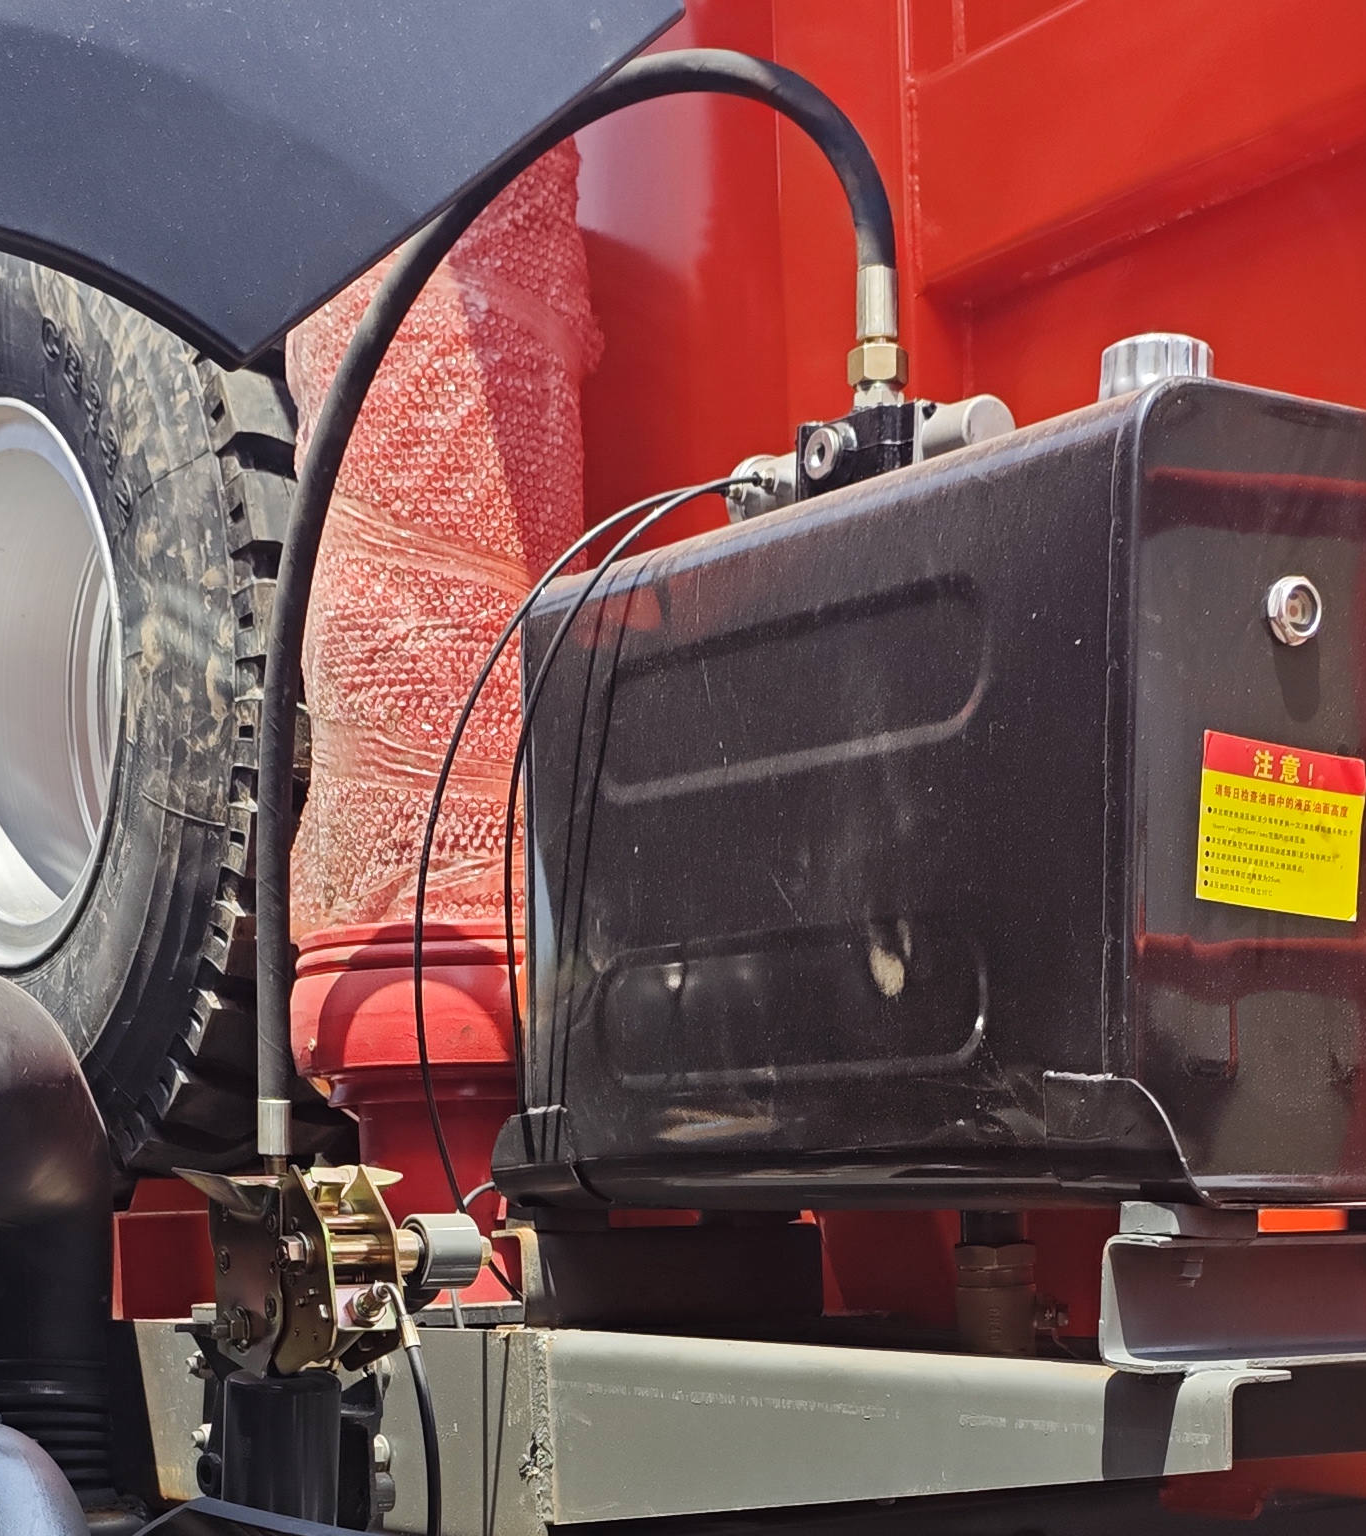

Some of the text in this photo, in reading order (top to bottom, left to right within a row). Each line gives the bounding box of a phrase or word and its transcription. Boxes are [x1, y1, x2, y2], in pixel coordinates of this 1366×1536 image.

[1214, 784, 1349, 819] 请每日检查油箱中的液压油面高度
